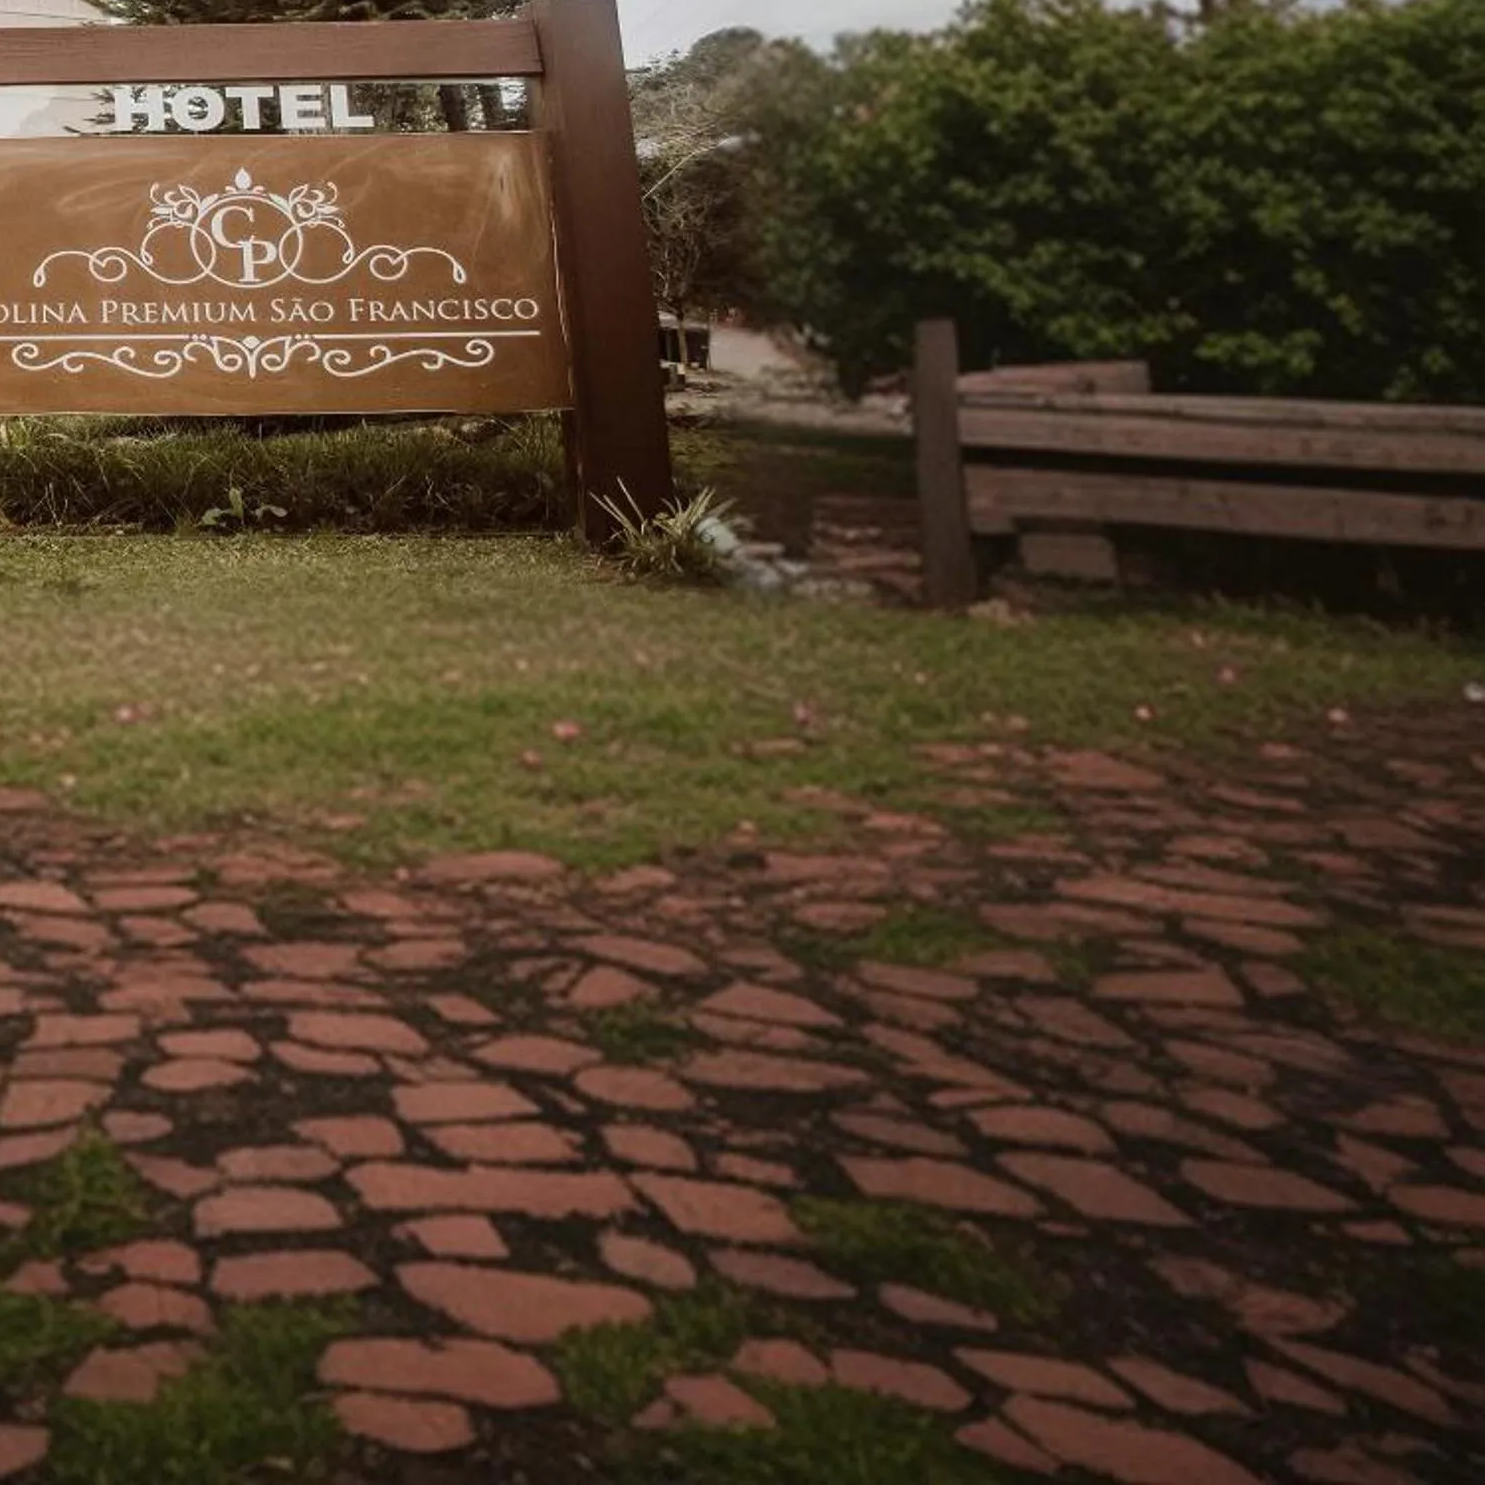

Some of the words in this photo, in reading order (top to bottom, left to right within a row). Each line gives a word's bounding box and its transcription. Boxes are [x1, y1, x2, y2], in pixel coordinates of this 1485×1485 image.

[115, 83, 375, 132] HOTEL
[100, 300, 257, 324] PREMIUM
[270, 298, 335, 323] SÃO
[348, 298, 539, 322] FRANCISCO
